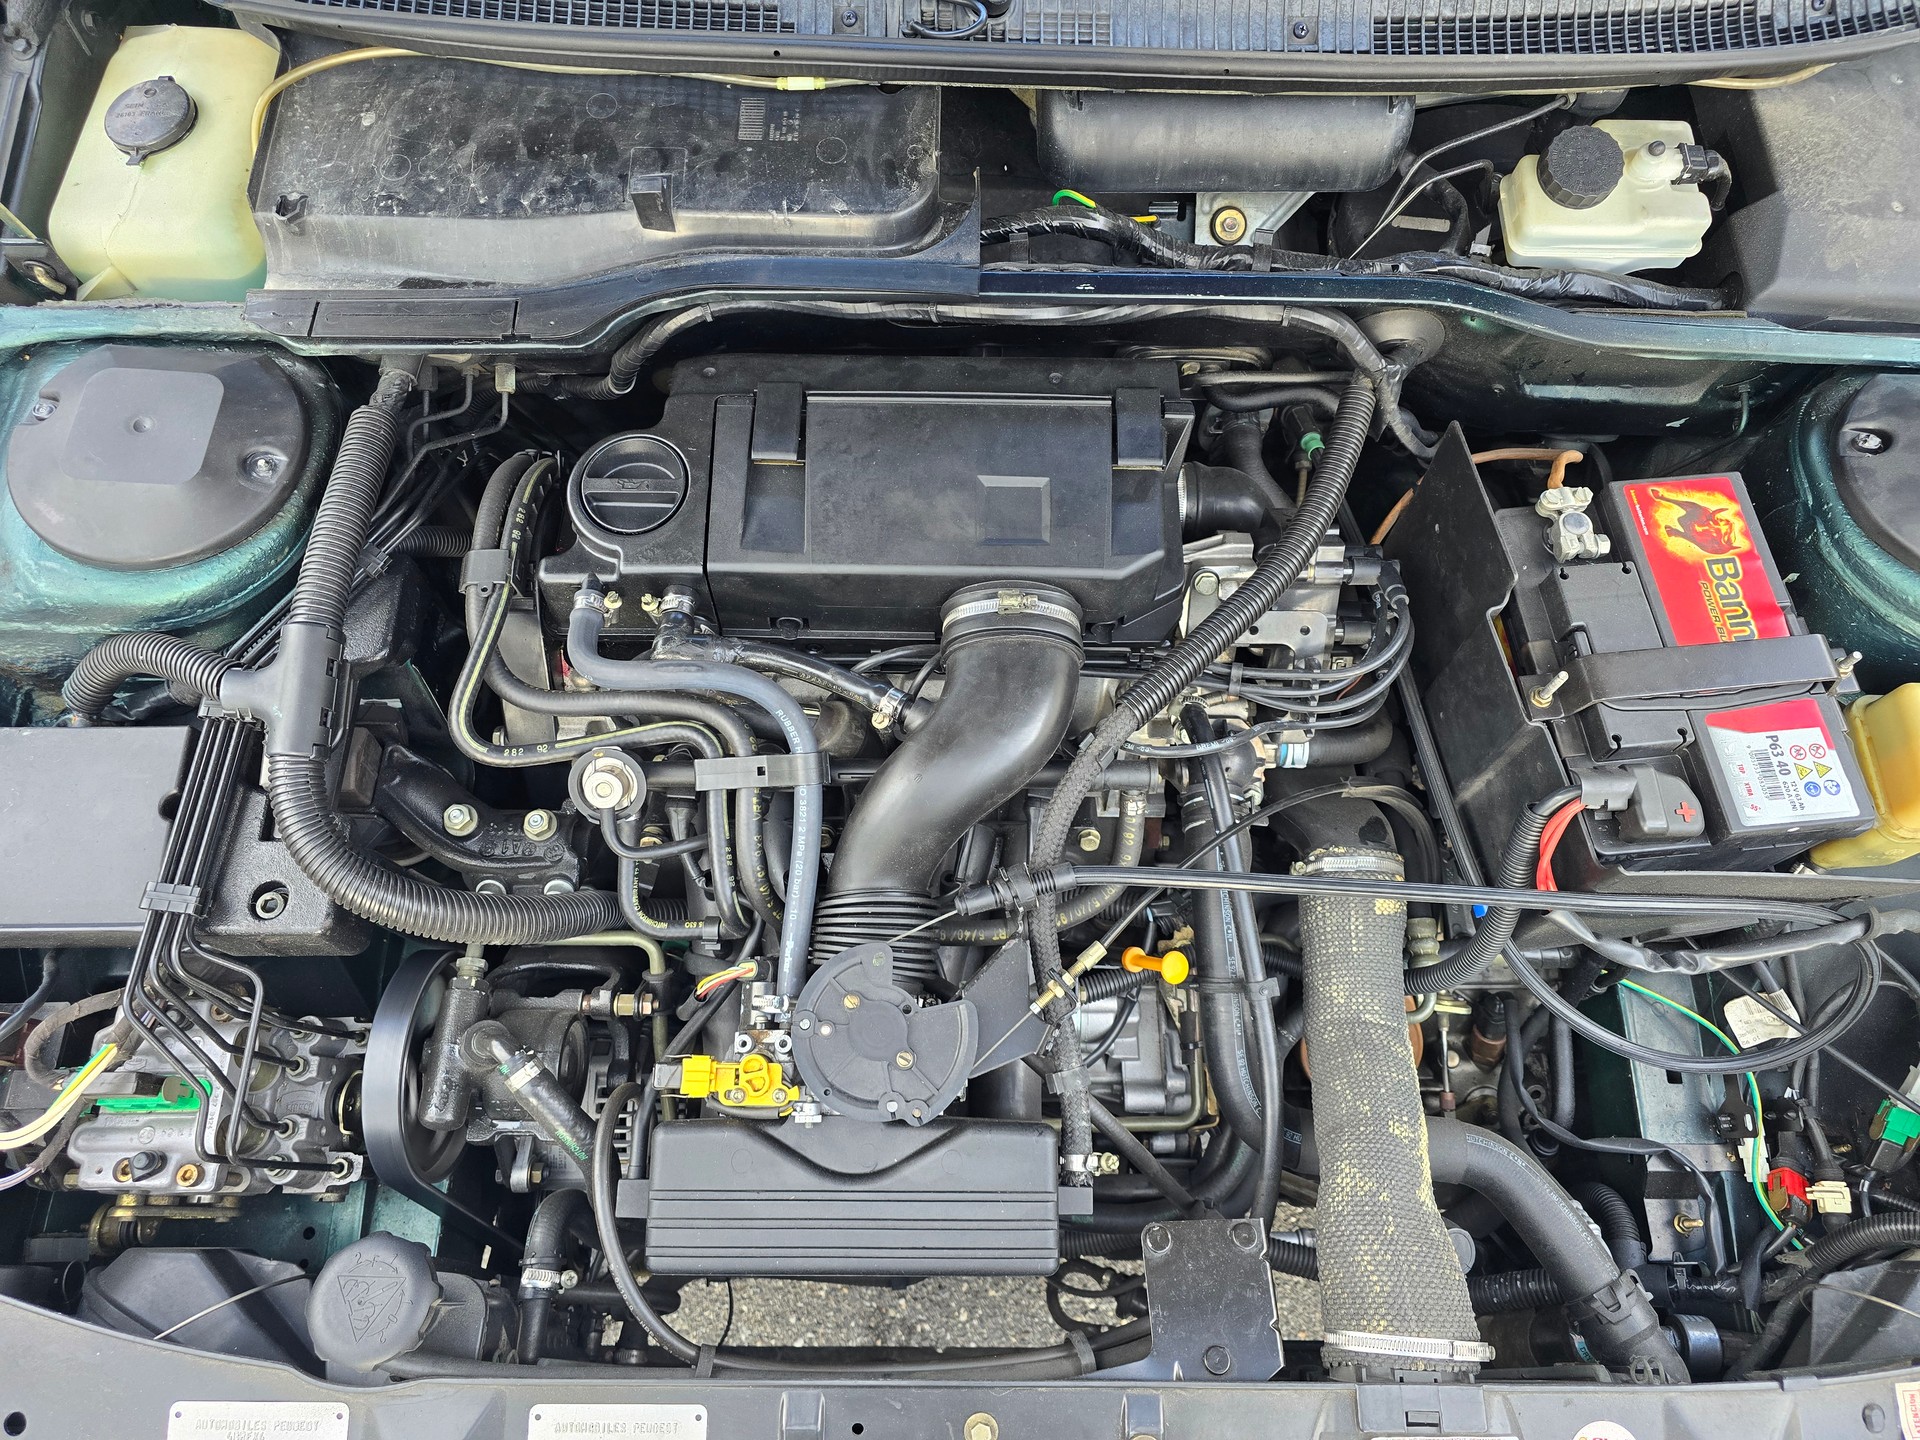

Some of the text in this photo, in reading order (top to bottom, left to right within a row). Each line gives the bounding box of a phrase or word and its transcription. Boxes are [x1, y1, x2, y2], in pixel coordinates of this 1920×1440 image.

[511, 507, 526, 540] 282 92
[1699, 579, 1722, 624] POWER
[775, 708, 801, 745] RUBBER
[503, 744, 549, 757] 282 92
[1765, 735, 1792, 776] P63 40
[1737, 763, 1746, 775] TOP
[1743, 782, 1754, 797] XTRA
[1782, 781, 1792, 793] 620
[1788, 798, 1799, 812] (EN)
[799, 799, 807, 823] 3821
[797, 836, 806, 861] MPa
[725, 846, 736, 887] 282 92
[795, 860, 803, 876] (20
[791, 877, 802, 899] bar)
[789, 910, 798, 920] 10
[1466, 1134, 1509, 1155] HUTCHINSON
[195, 1418, 268, 1432] AUTOMOBILES
[554, 1421, 628, 1434] AUTOMOBILES
